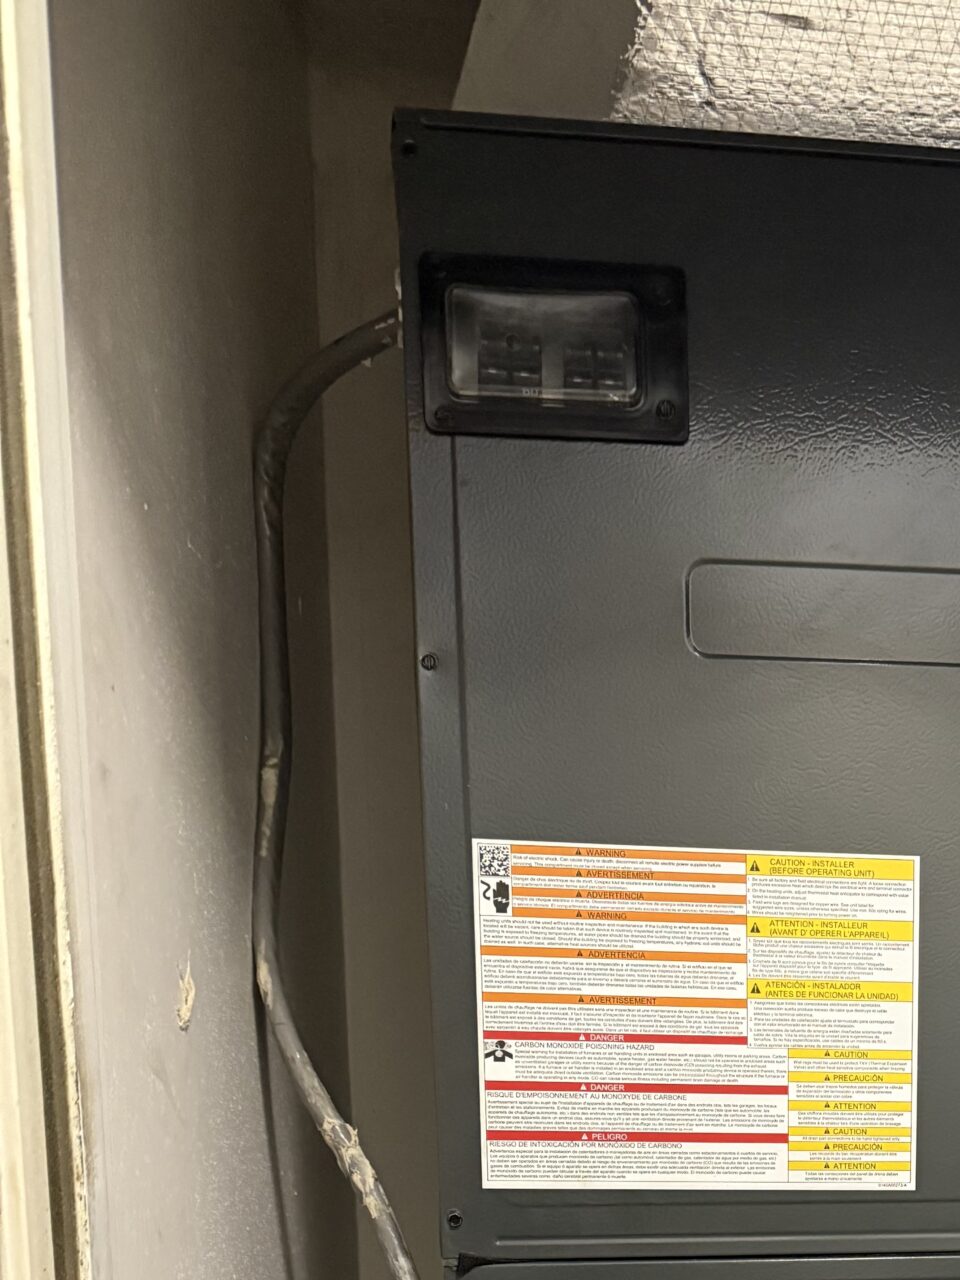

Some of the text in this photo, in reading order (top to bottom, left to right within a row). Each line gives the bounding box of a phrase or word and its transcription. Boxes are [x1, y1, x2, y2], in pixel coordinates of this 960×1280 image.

[586, 849, 626, 858] WARNING
[770, 858, 854, 869] CAUTION INSTALLER
[586, 870, 655, 880] AVERTISSEMENT
[769, 867, 875, 879] (BEFORE OPERATING UNIT)
[586, 891, 645, 900] ADVERTENCIA
[587, 911, 627, 920] WARNING
[769, 919, 868, 930] ATTENTION INSTALLEUR
[769, 929, 798, 937] (AVANT
[809, 930, 842, 938] OPERER
[843, 930, 890, 940] L'APPAREIL)
[588, 950, 646, 960] ADVERTENCIA
[765, 980, 861, 991] ATENCIÓN INSTALADOR
[765, 990, 794, 998] (ANTES
[796, 990, 807, 998] DE
[808, 991, 854, 999] FUNCIONAR
[866, 992, 899, 1001] UNIDAD)
[589, 995, 656, 1006] AVERTISSEMENT
[590, 1034, 625, 1042] DANGER
[514, 1041, 545, 1049] CARBON
[546, 1042, 584, 1050] MONOXIDE
[626, 1043, 655, 1051] HAZARD
[833, 1050, 869, 1059] CAUTION
[833, 1073, 884, 1082] PRECAUCIÓN
[590, 1083, 625, 1092] DANGER
[515, 1092, 588, 1100] D'EMPOISONNEMENT
[601, 1093, 641, 1101] MONOXYDE
[833, 1102, 877, 1111] ATTENTION
[833, 1128, 868, 1136] CAUTION
[591, 1133, 628, 1141] PELIGRO
[530, 1141, 580, 1149] INTOXICACIÓN
[597, 1141, 636, 1149] MONÓXIDO
[832, 1142, 883, 1151] PRECAUCIÓN
[833, 1162, 877, 1170] ATTENTION
